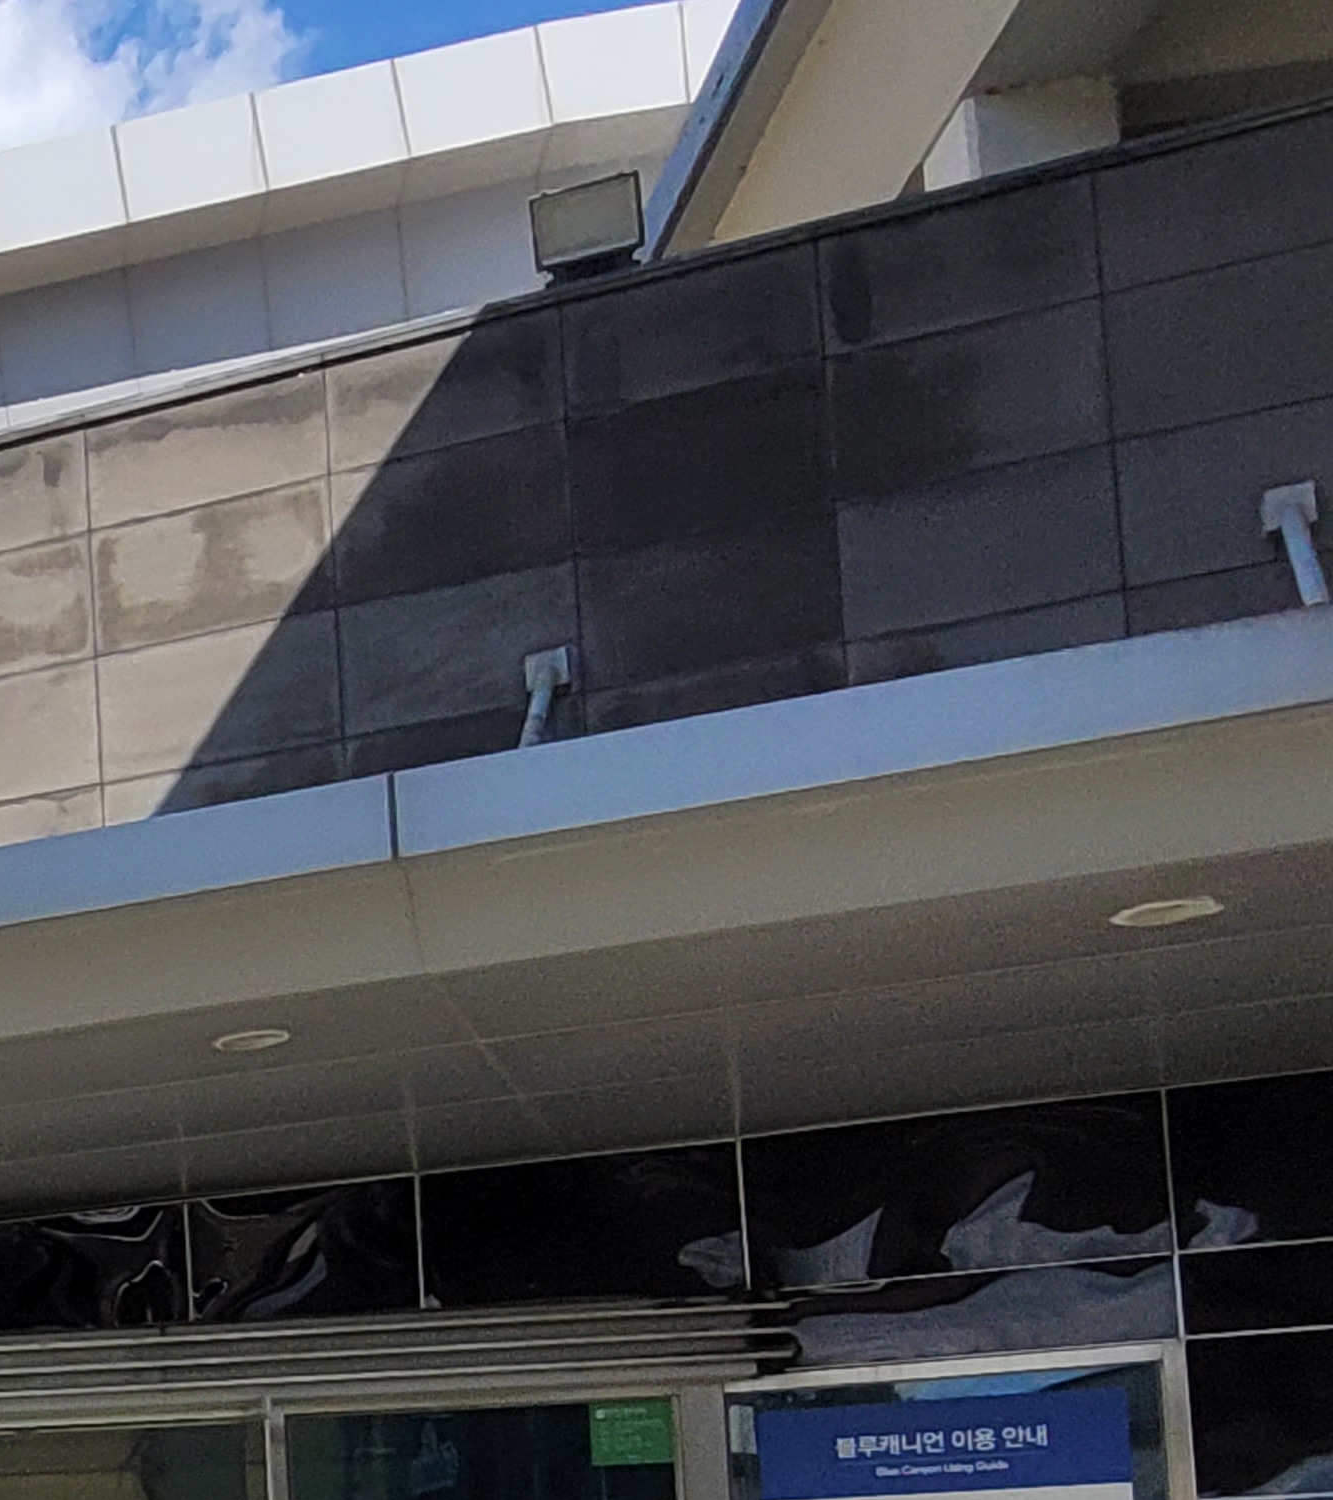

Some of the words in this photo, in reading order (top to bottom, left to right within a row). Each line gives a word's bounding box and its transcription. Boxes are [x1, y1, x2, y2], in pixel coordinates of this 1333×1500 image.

[835, 1431, 946, 1459] 블루캐니언
[951, 1427, 997, 1451] 이용
[1001, 1424, 1049, 1448] 안내
